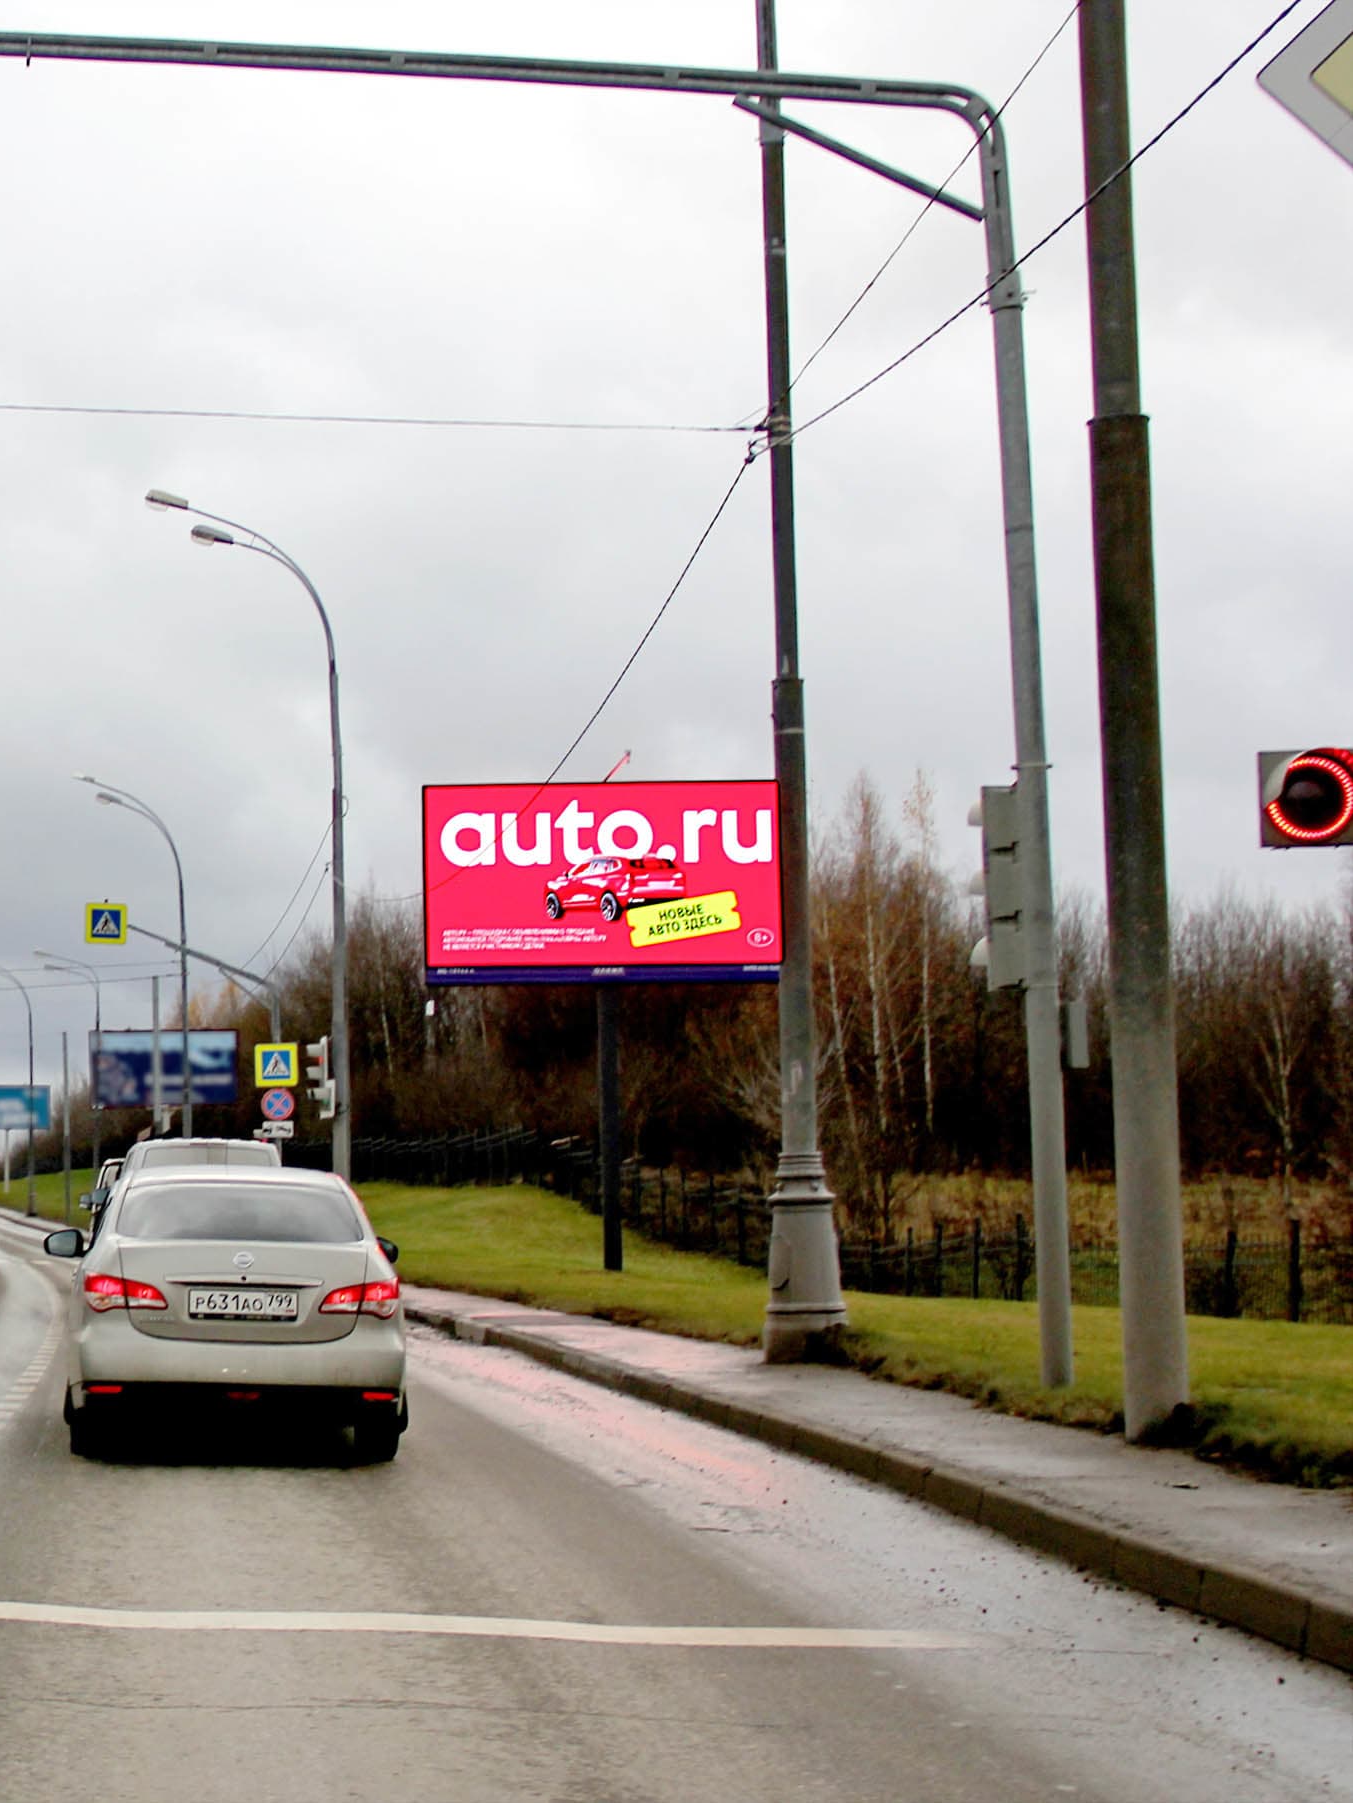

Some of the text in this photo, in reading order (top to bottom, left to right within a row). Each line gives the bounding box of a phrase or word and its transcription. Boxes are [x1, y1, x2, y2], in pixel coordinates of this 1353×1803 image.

[440, 799, 773, 867] auto.ru
[658, 903, 703, 921] НОВЫЕ
[648, 914, 723, 938] АВТО ЗДЕСЬ
[195, 1293, 293, 1312] Р631АО 799
